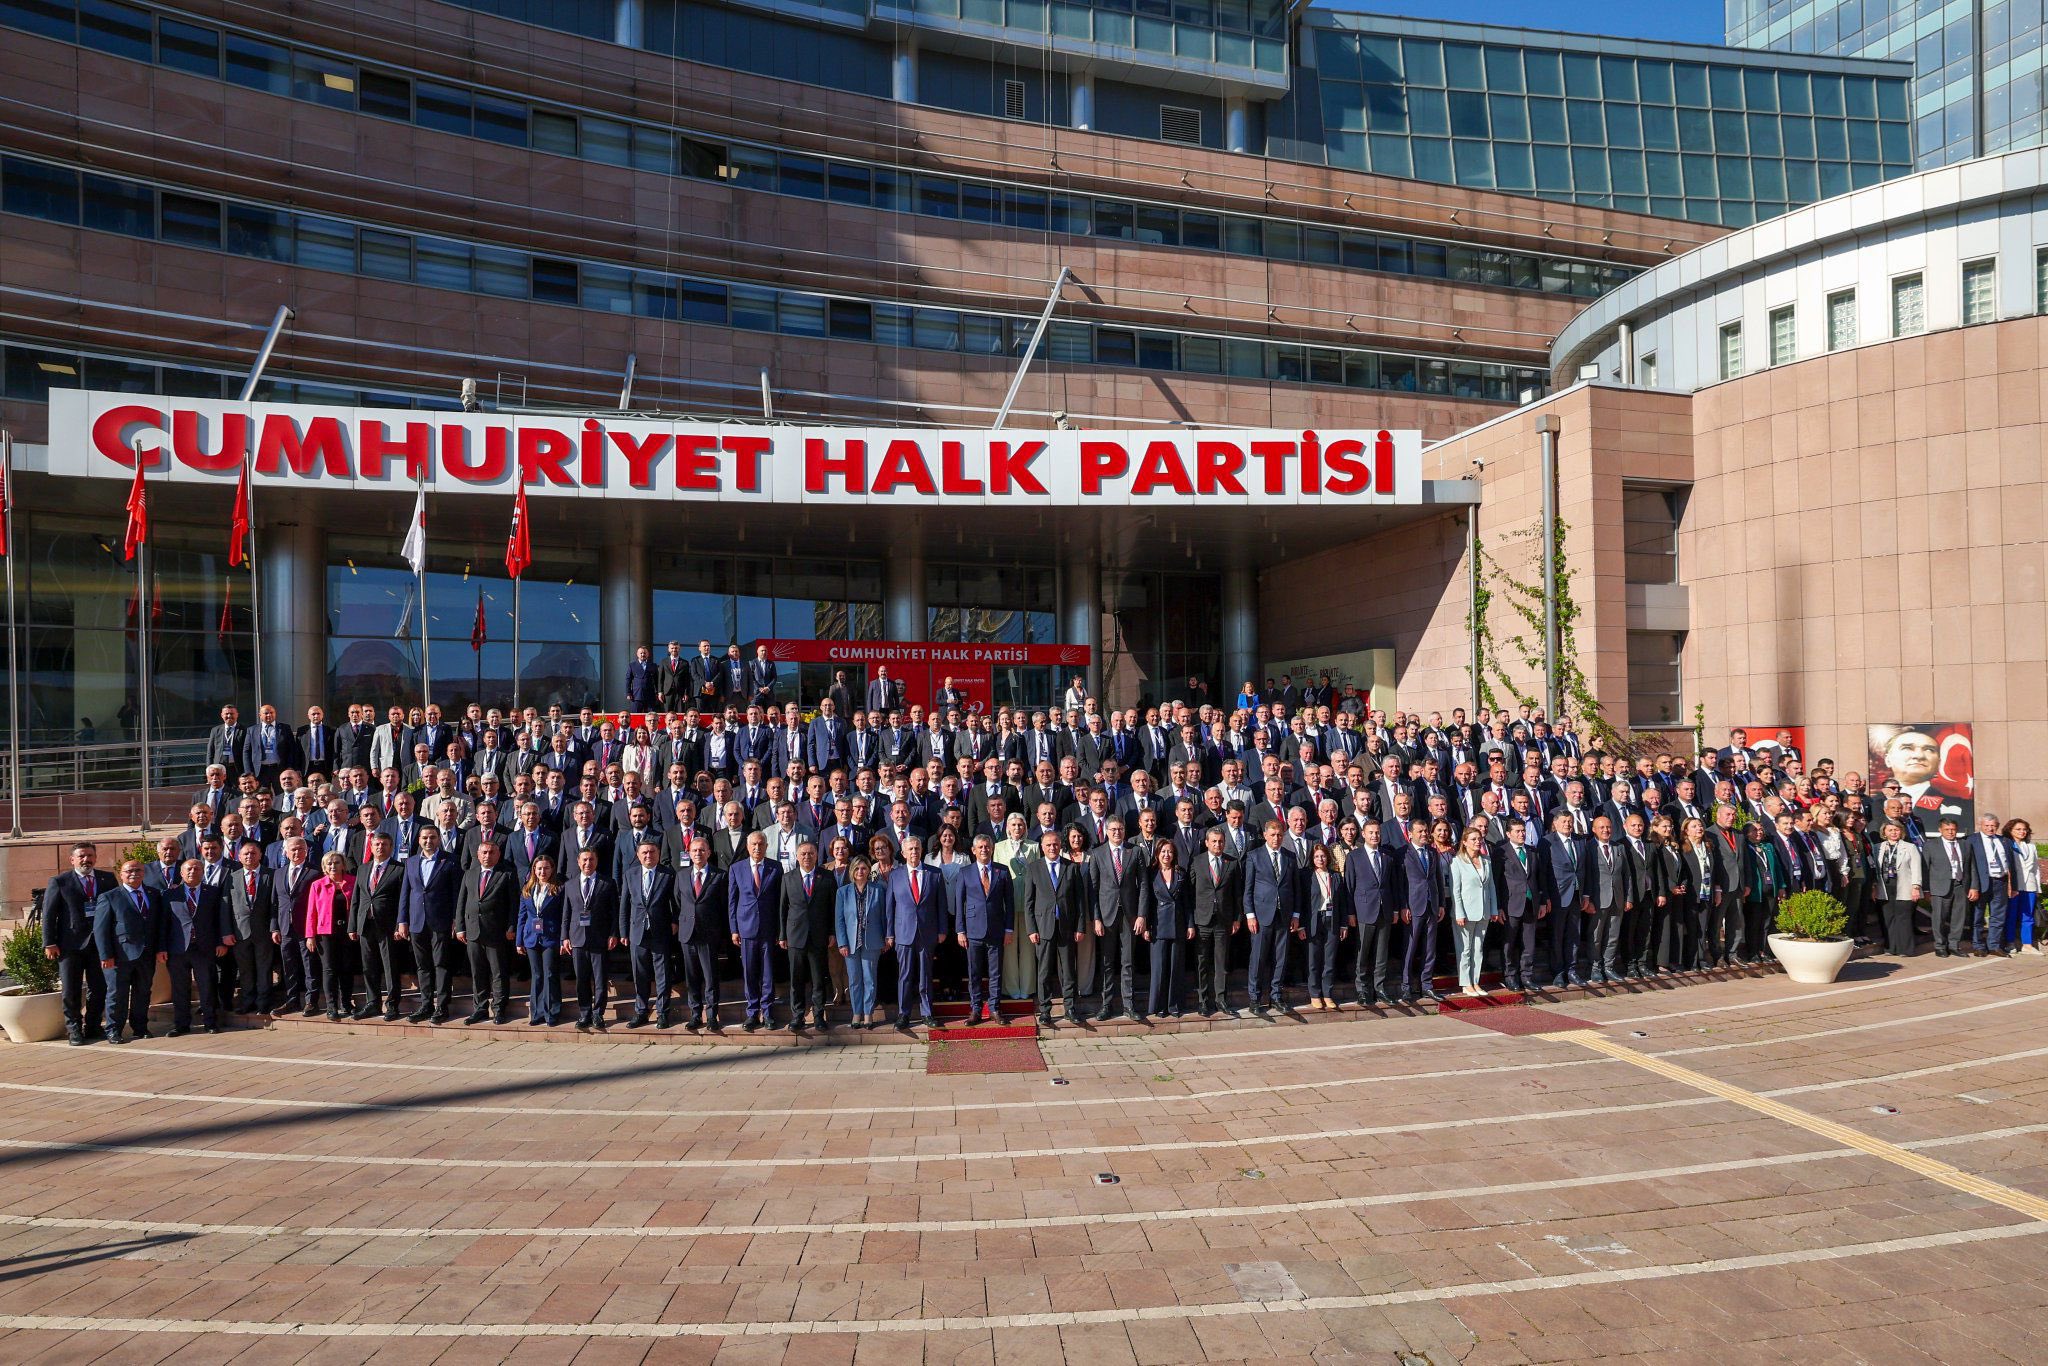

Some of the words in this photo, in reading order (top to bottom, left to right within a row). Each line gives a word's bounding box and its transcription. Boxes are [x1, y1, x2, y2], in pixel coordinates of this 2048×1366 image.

[92, 405, 771, 491] CUMHURİYET
[804, 438, 1048, 494] HALK
[1078, 429, 1395, 495] PARTİSİ
[829, 645, 926, 660] CUMHURİYET
[931, 648, 969, 660] HALK
[974, 647, 1029, 661] PARTİSİ
